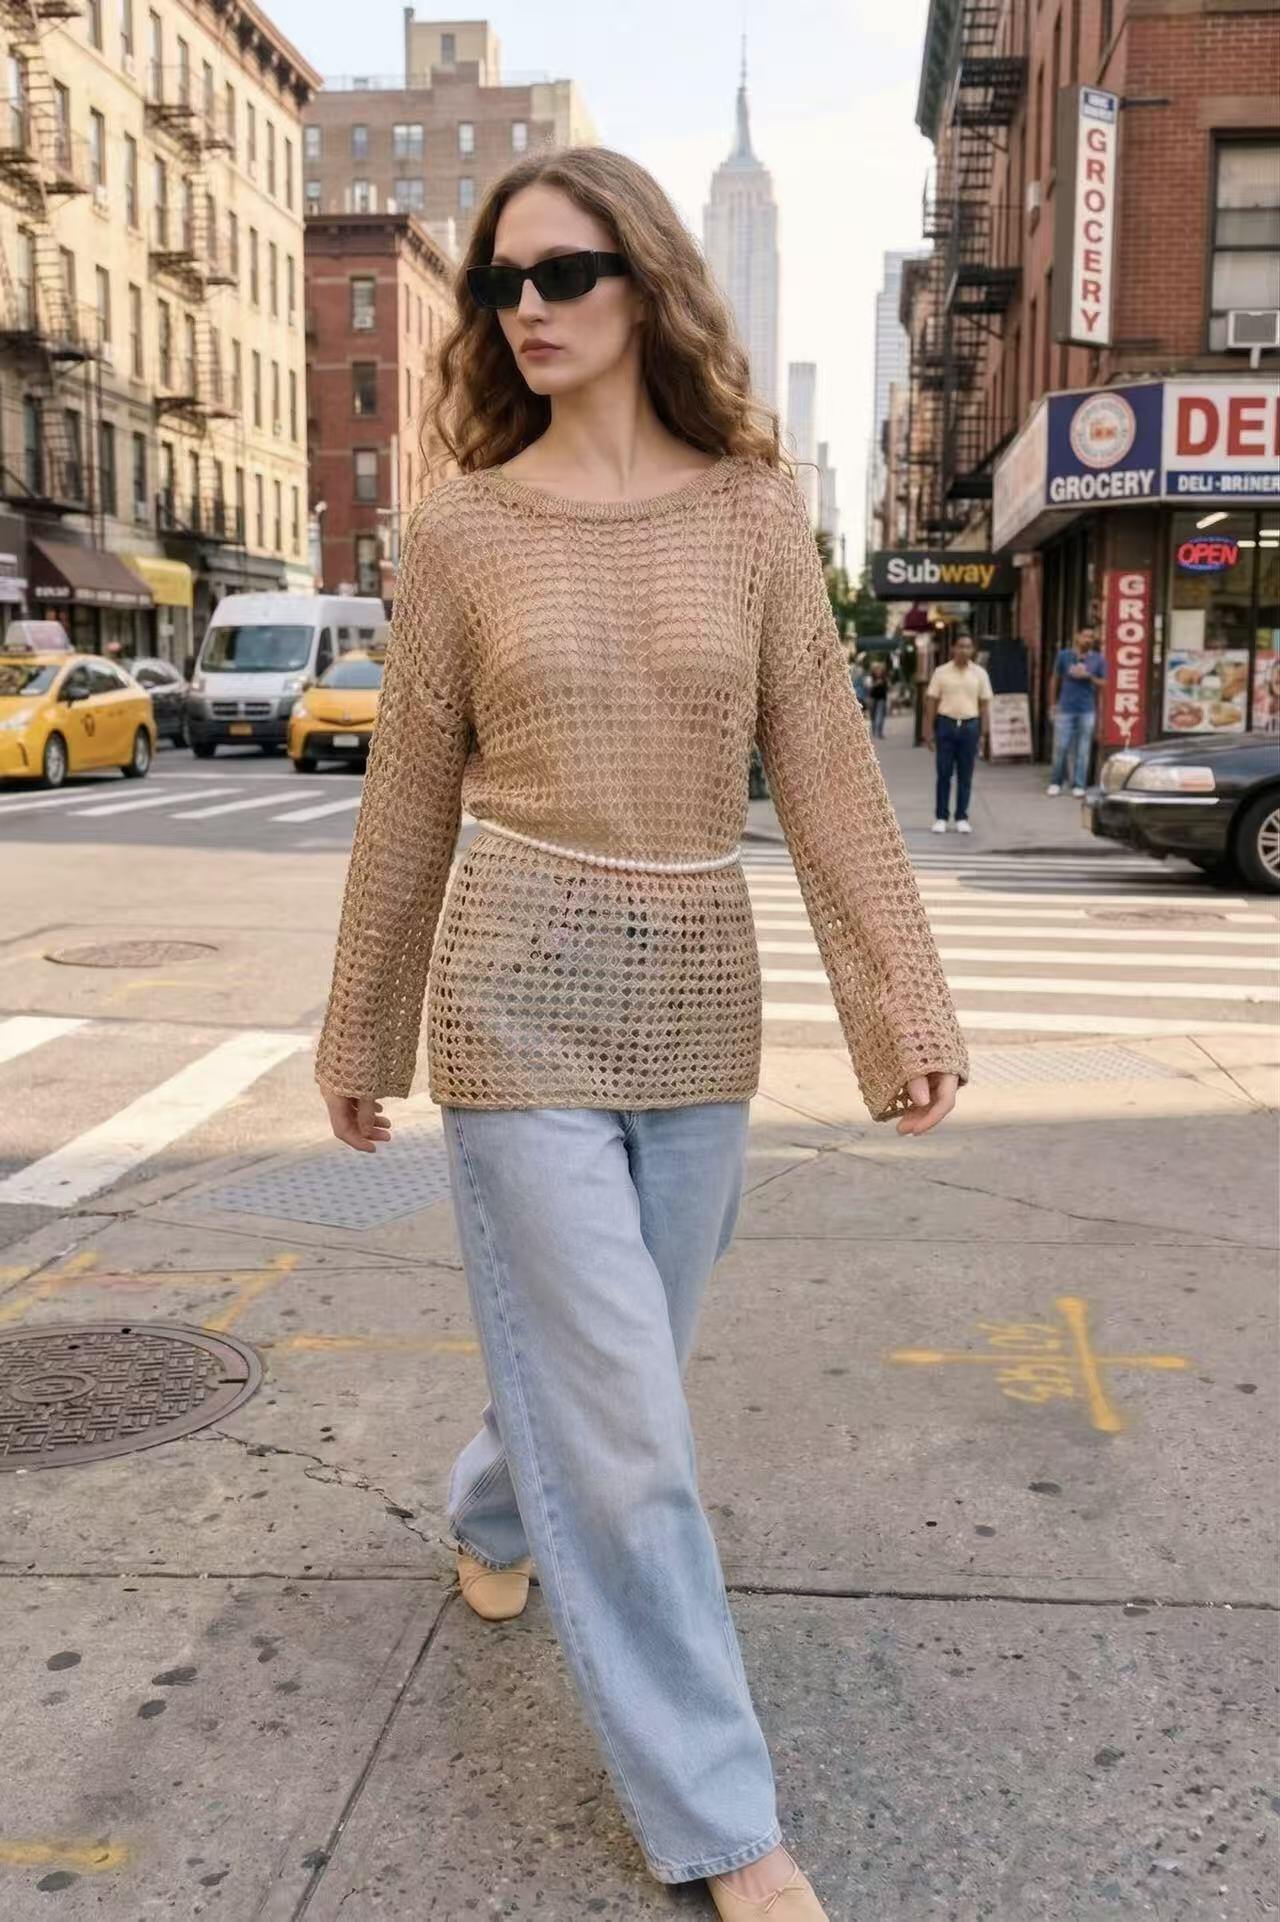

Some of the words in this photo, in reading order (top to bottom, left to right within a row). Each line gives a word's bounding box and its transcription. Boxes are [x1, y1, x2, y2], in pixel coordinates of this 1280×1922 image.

[1081, 129, 1107, 332] GROCERY
[1176, 397, 1280, 456] DE
[1050, 469, 1155, 502] GROCERY
[887, 558, 995, 589] Subway
[1178, 543, 1239, 564] OPEN
[1113, 575, 1145, 737] GROCERY
